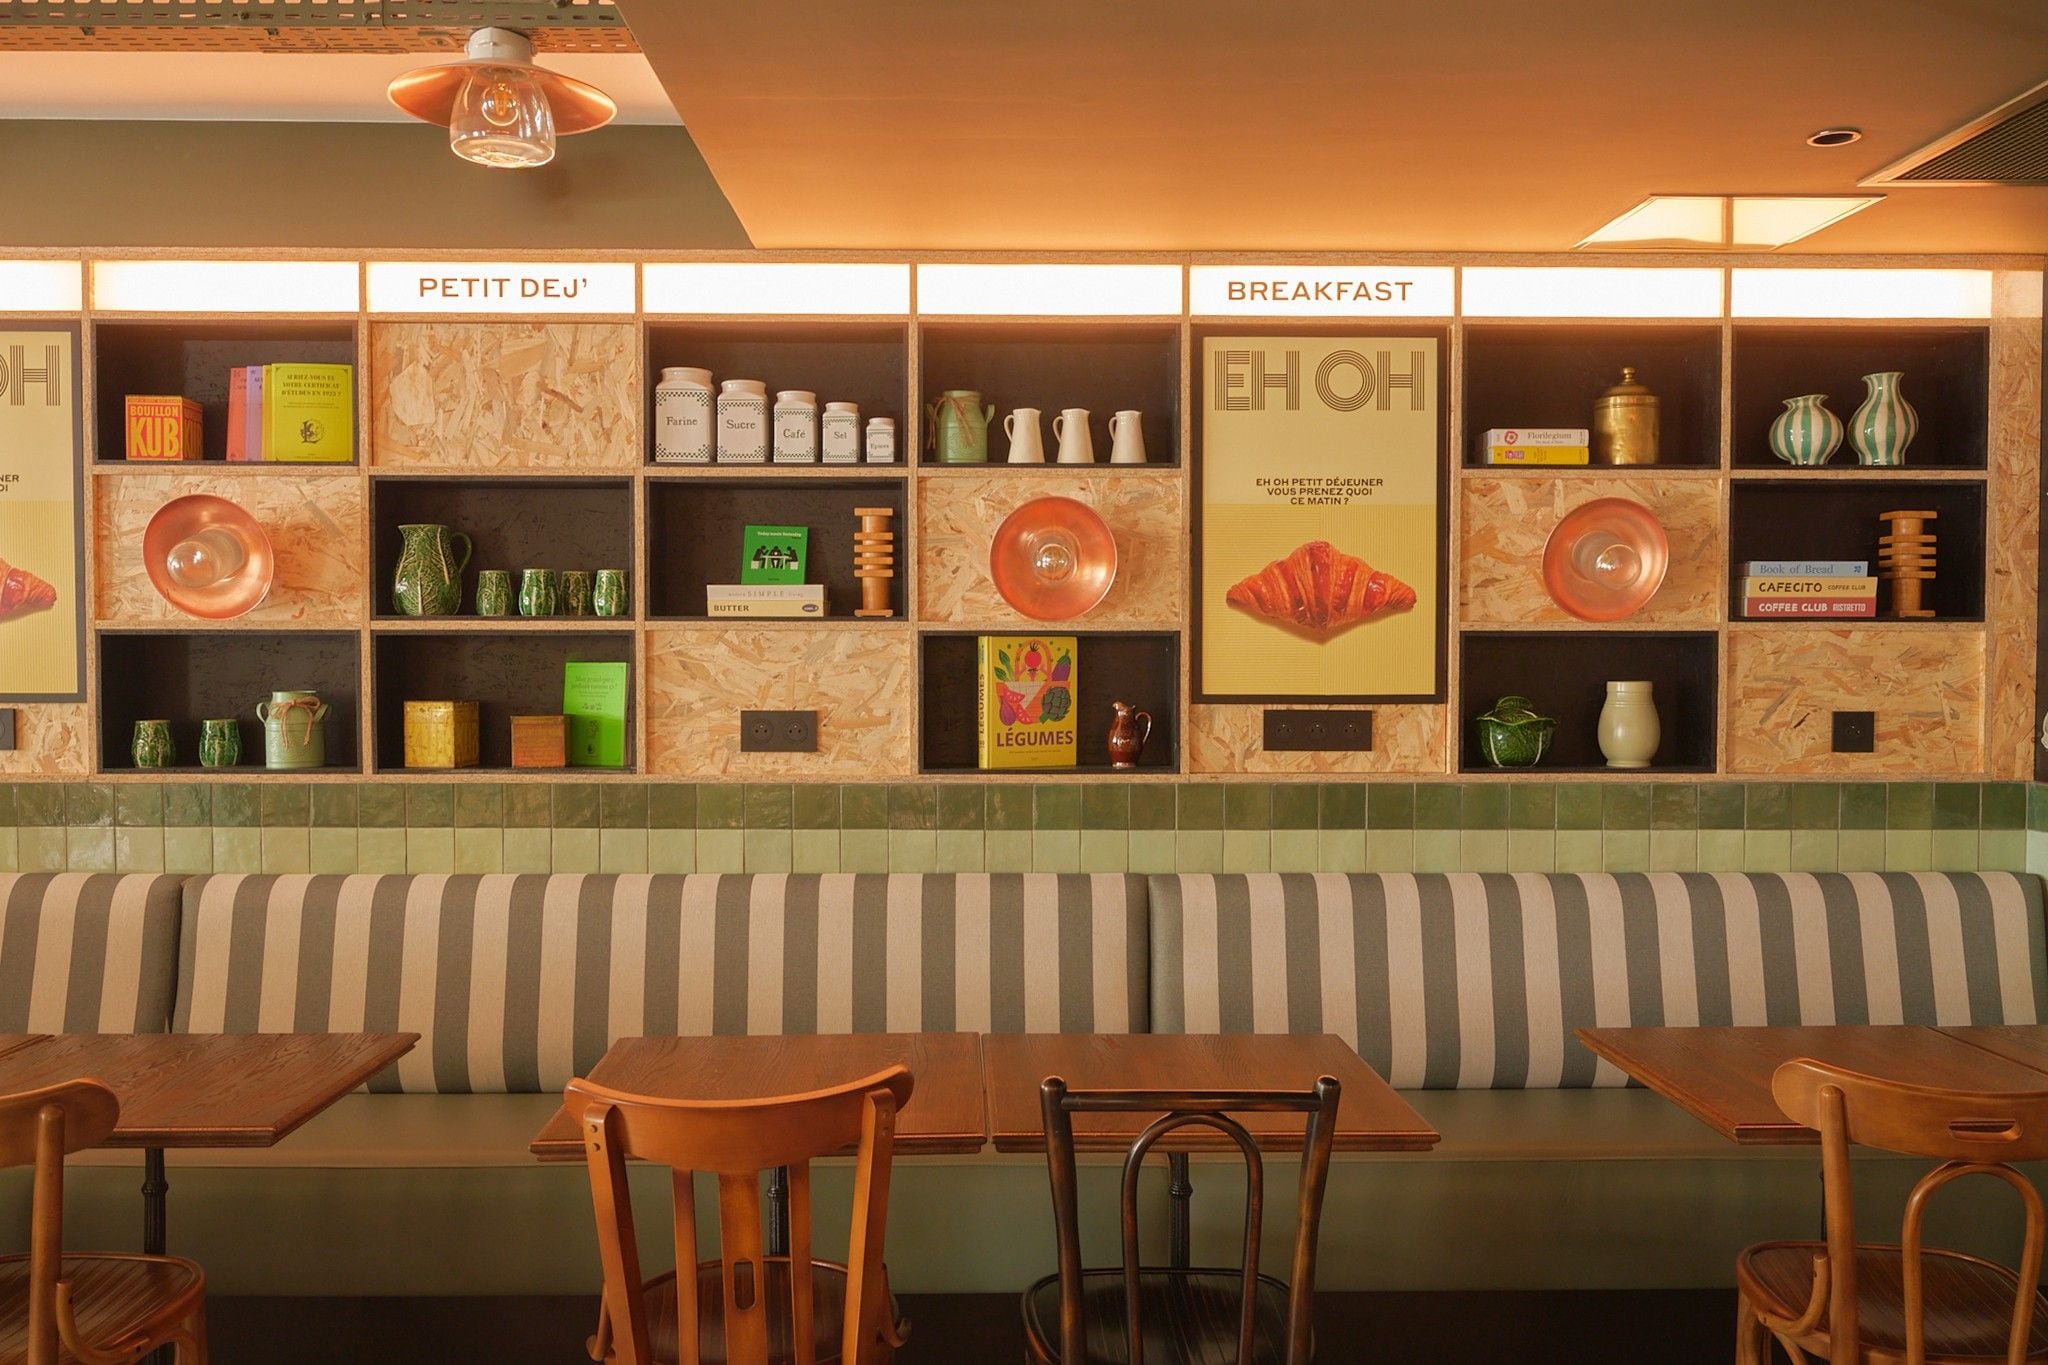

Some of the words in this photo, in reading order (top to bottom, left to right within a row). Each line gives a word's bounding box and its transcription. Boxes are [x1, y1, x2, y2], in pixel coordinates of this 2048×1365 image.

[419, 278, 511, 297] PETIT
[521, 278, 587, 298] DEJ'
[1228, 281, 1413, 301] BREAKFAST
[1214, 350, 1300, 411] EH
[1315, 350, 1425, 412] OH
[130, 405, 178, 417] BOUILLON
[666, 416, 698, 426] Farine
[726, 419, 756, 429] Sucre
[130, 417, 180, 457] KUB
[783, 428, 806, 439] Café
[833, 431, 847, 439] Sel
[1256, 478, 1271, 487] EH
[1273, 478, 1289, 487] OH
[1292, 478, 1323, 487] PETIT
[1325, 476, 1384, 487] DÉJEUNER
[1267, 487, 1297, 496] VOUS
[1299, 487, 1343, 496] PRENEZ
[1346, 487, 1373, 496] QUOI
[1290, 497, 1305, 505] CE
[1307, 497, 1341, 505] MATIN
[1344, 497, 1350, 505] ?
[1760, 564, 1784, 574] Book
[1789, 564, 1800, 574] of
[1805, 564, 1834, 574] Bread
[1758, 582, 1823, 593] CAFECITO
[1758, 603, 1798, 612] COFFEE
[1801, 603, 1828, 612] CLUB
[996, 727, 1074, 747] LÉGUMES
